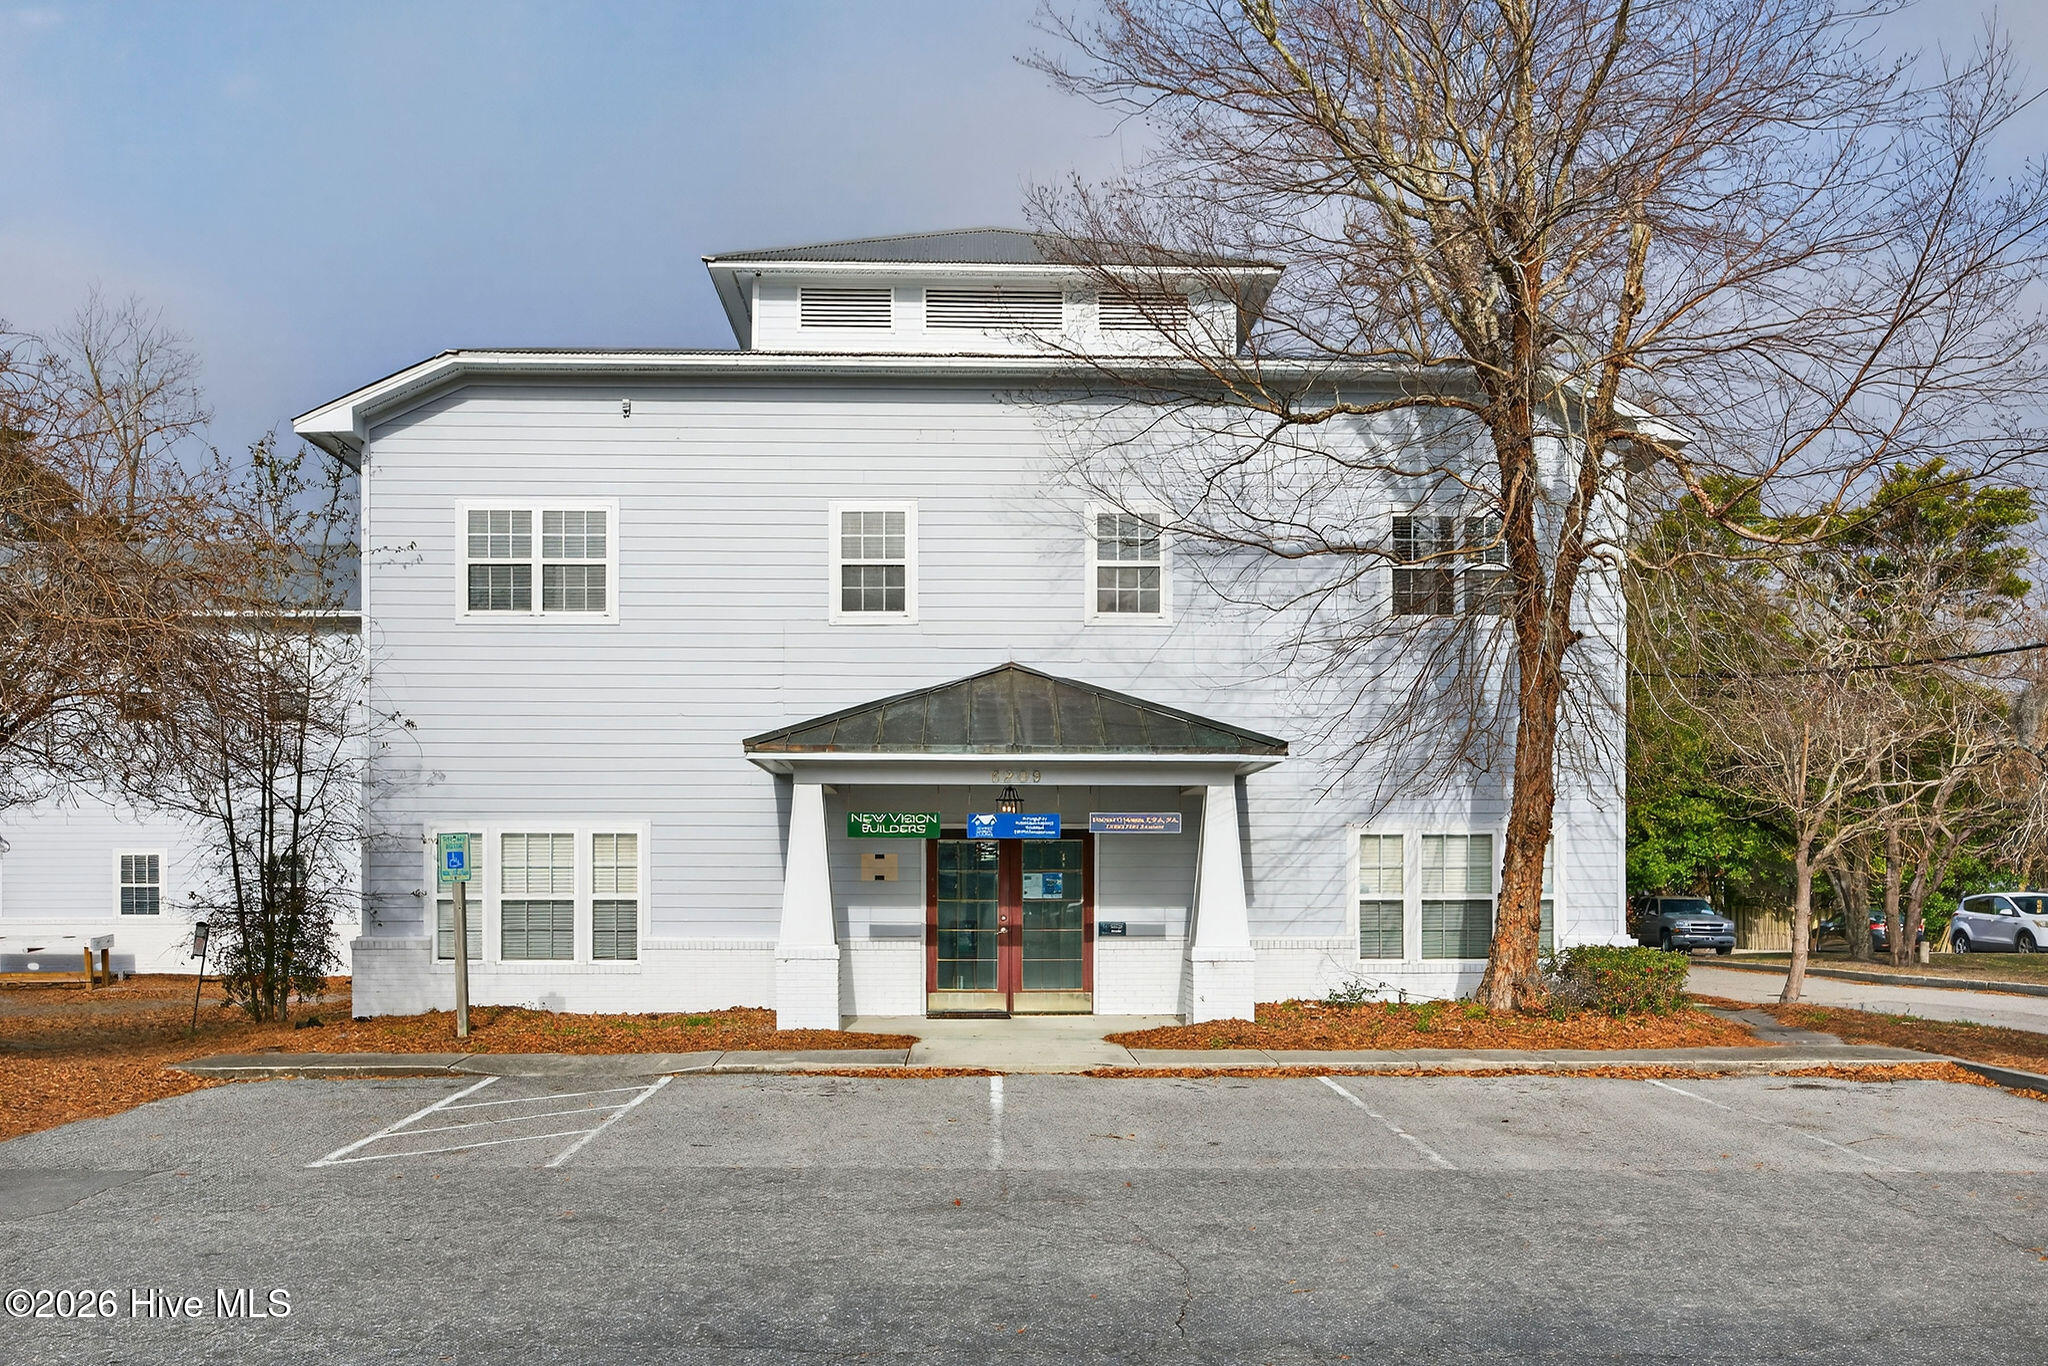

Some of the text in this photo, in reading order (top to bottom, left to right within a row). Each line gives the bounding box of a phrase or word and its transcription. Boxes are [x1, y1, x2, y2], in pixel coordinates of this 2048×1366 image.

[851, 813, 937, 824] NEW VISION
[861, 823, 927, 834] BUILDERS
